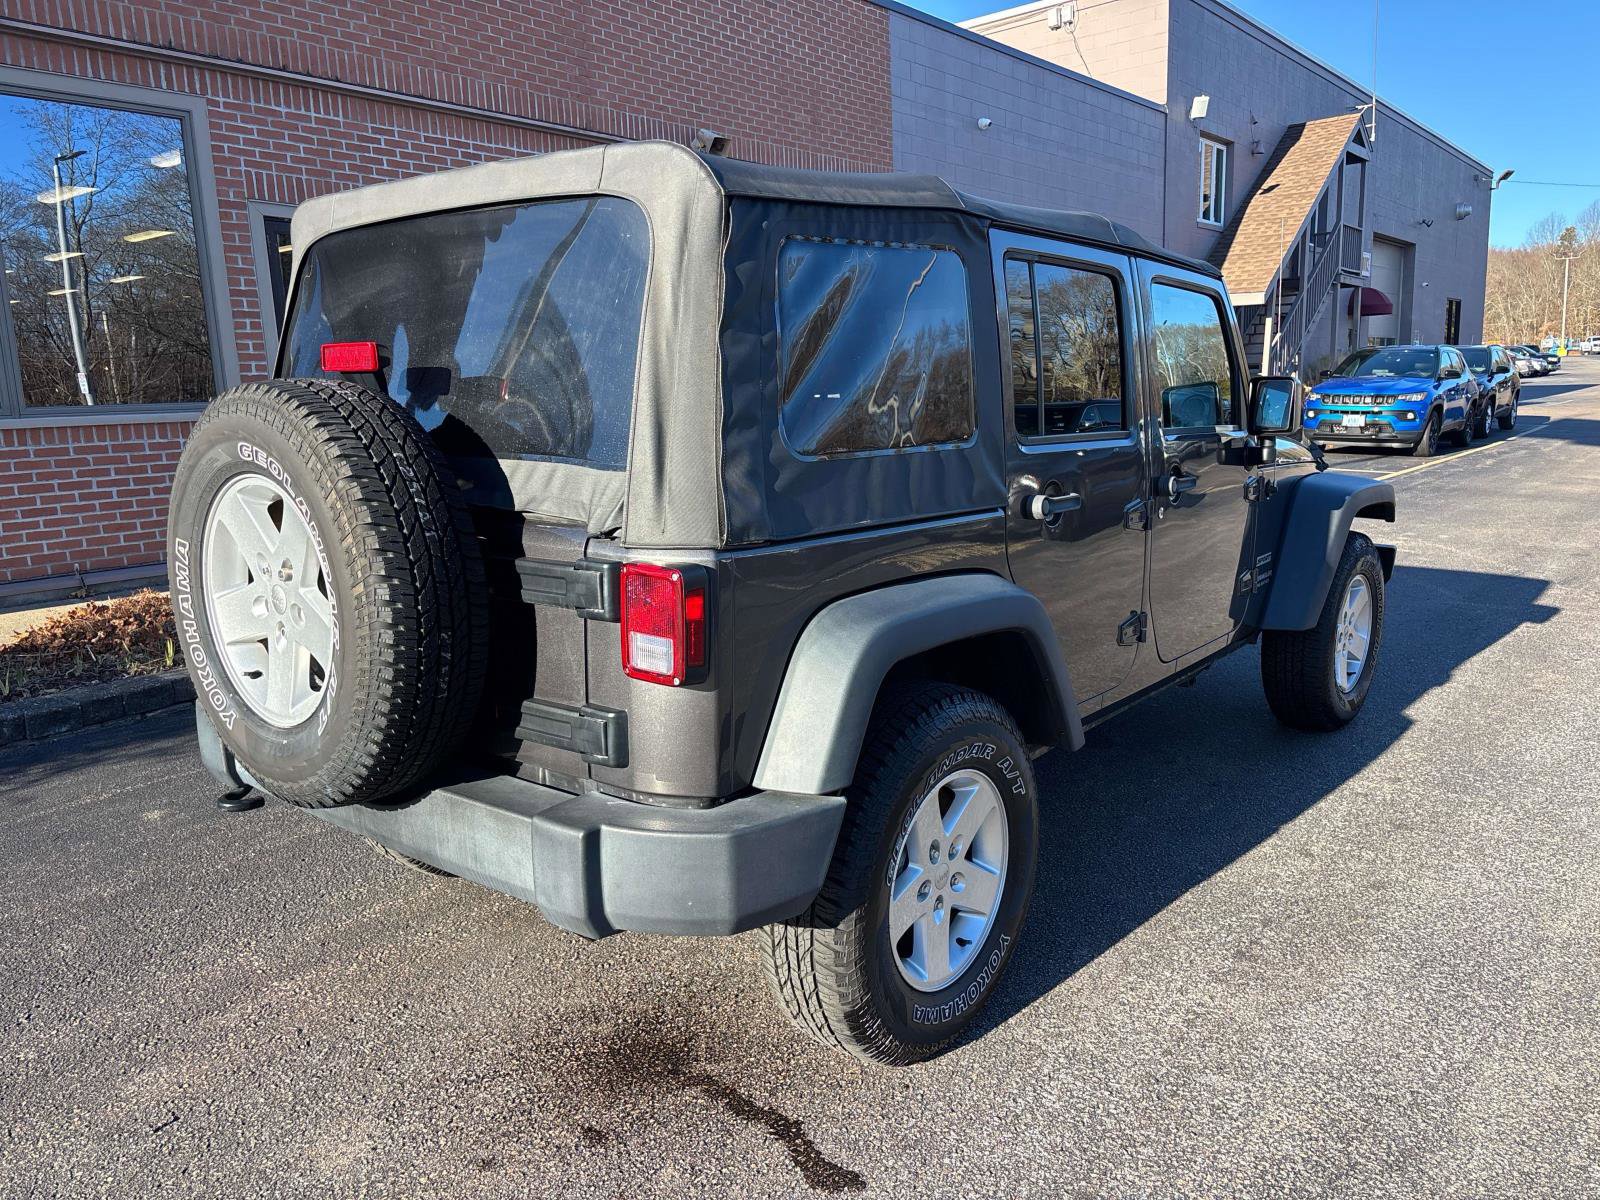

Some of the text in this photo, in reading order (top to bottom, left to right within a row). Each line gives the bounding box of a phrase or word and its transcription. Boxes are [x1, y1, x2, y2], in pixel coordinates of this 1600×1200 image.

[175, 537, 237, 731] YOKOHAMA
[996, 755, 1026, 795] A/T
[912, 934, 1011, 1025] YOKOHAMA
